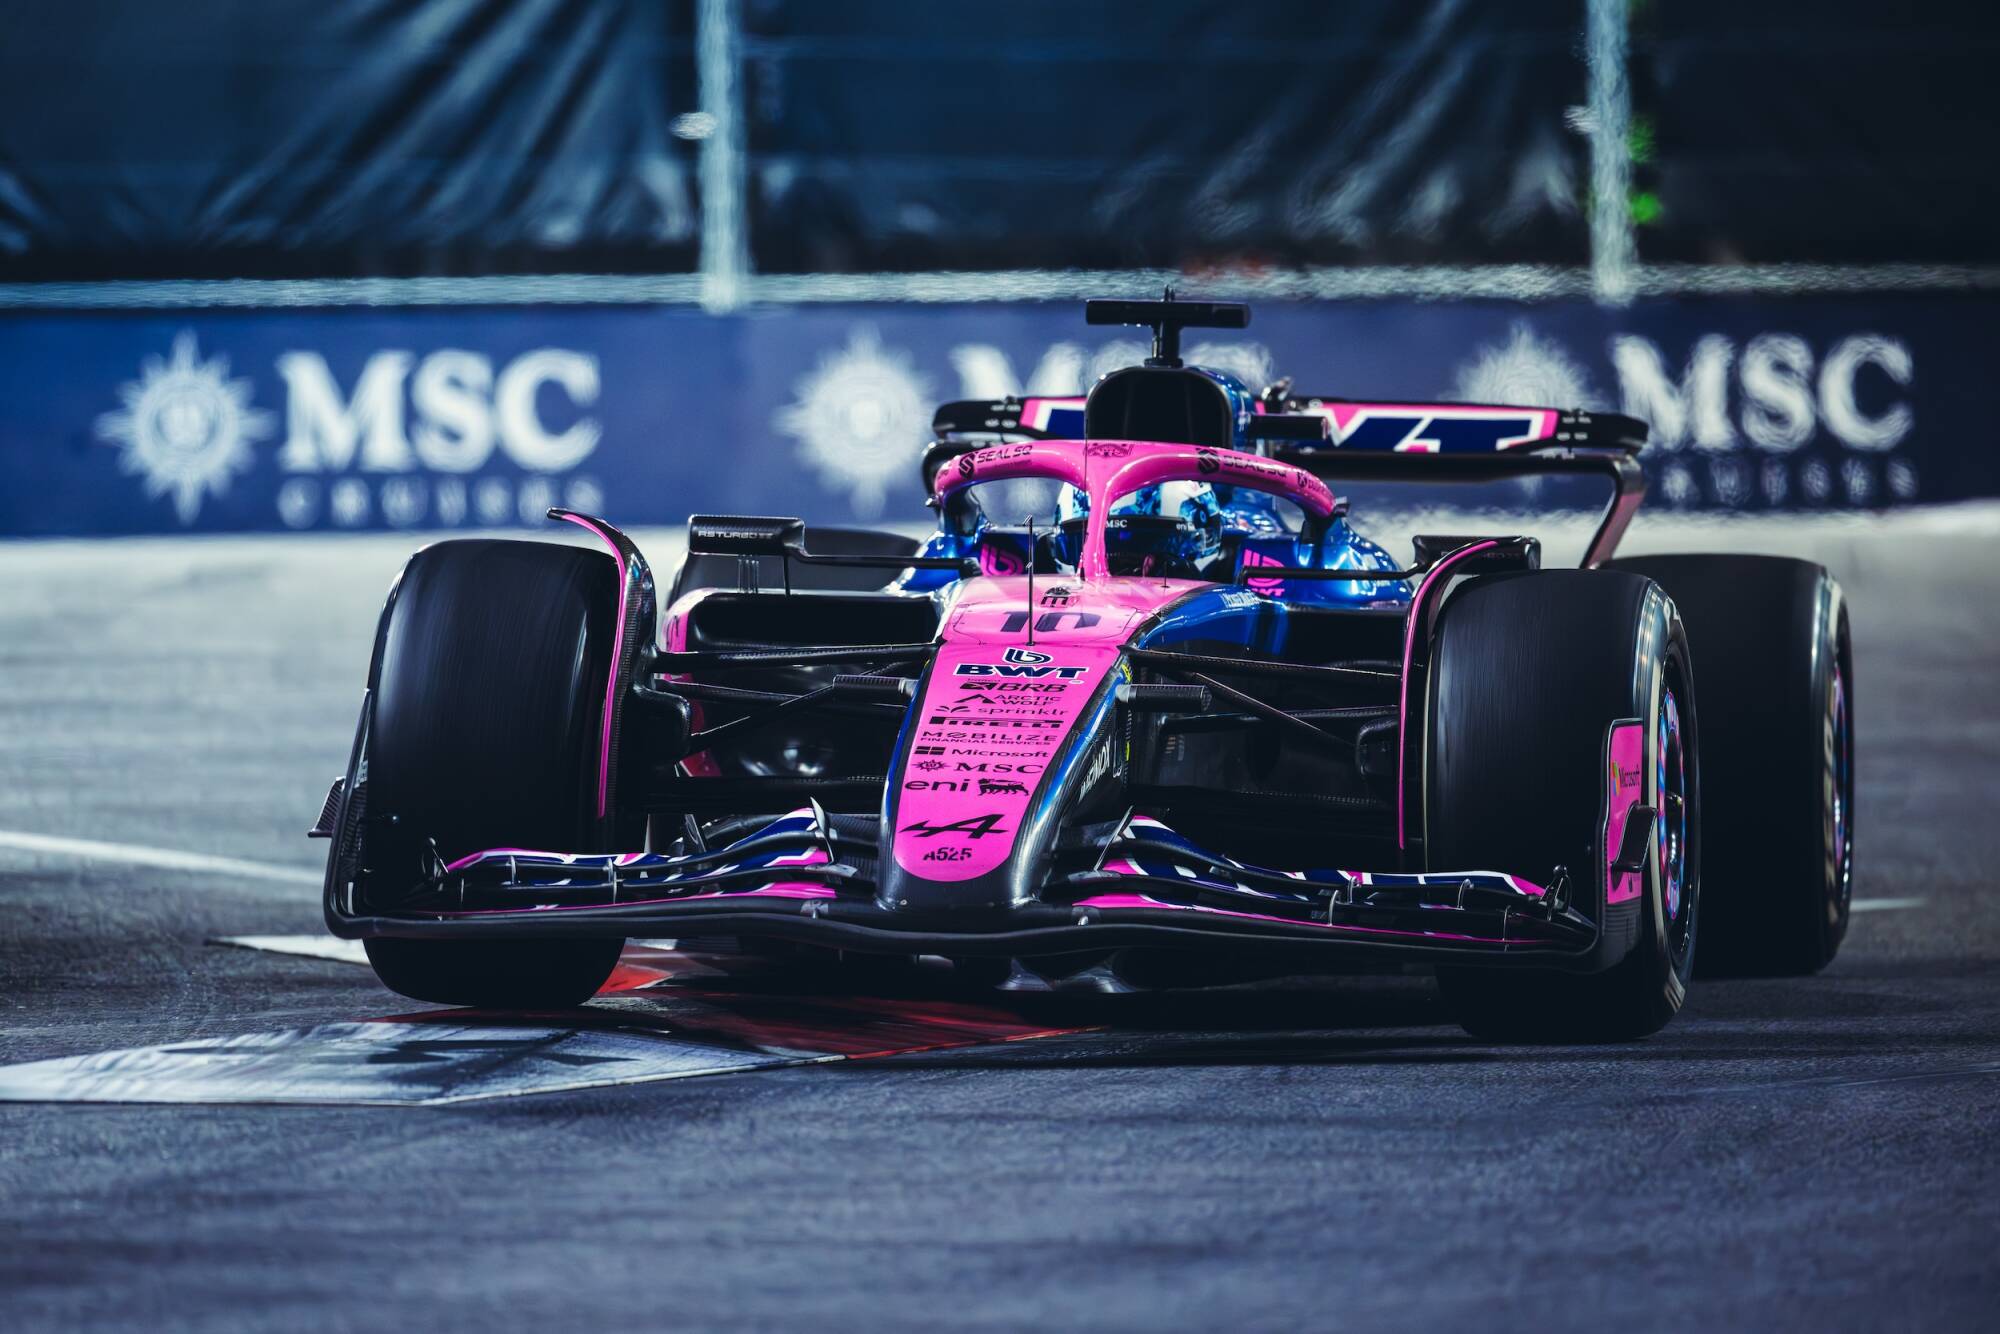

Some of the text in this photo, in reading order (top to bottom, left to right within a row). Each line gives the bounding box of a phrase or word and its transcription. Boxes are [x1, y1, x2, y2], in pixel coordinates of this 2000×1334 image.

[1609, 333, 1913, 453] MSC
[276, 348, 601, 473] MSC
[1105, 519, 1128, 528] MSC
[1000, 611, 1101, 632] 10
[954, 665, 1088, 679] BWT
[997, 683, 1067, 692] BRB
[978, 707, 1068, 716] sprinklr
[951, 749, 1049, 758] Microsoft
[954, 762, 1044, 774] MSC
[905, 779, 970, 792] eni
[923, 847, 973, 861] A525
